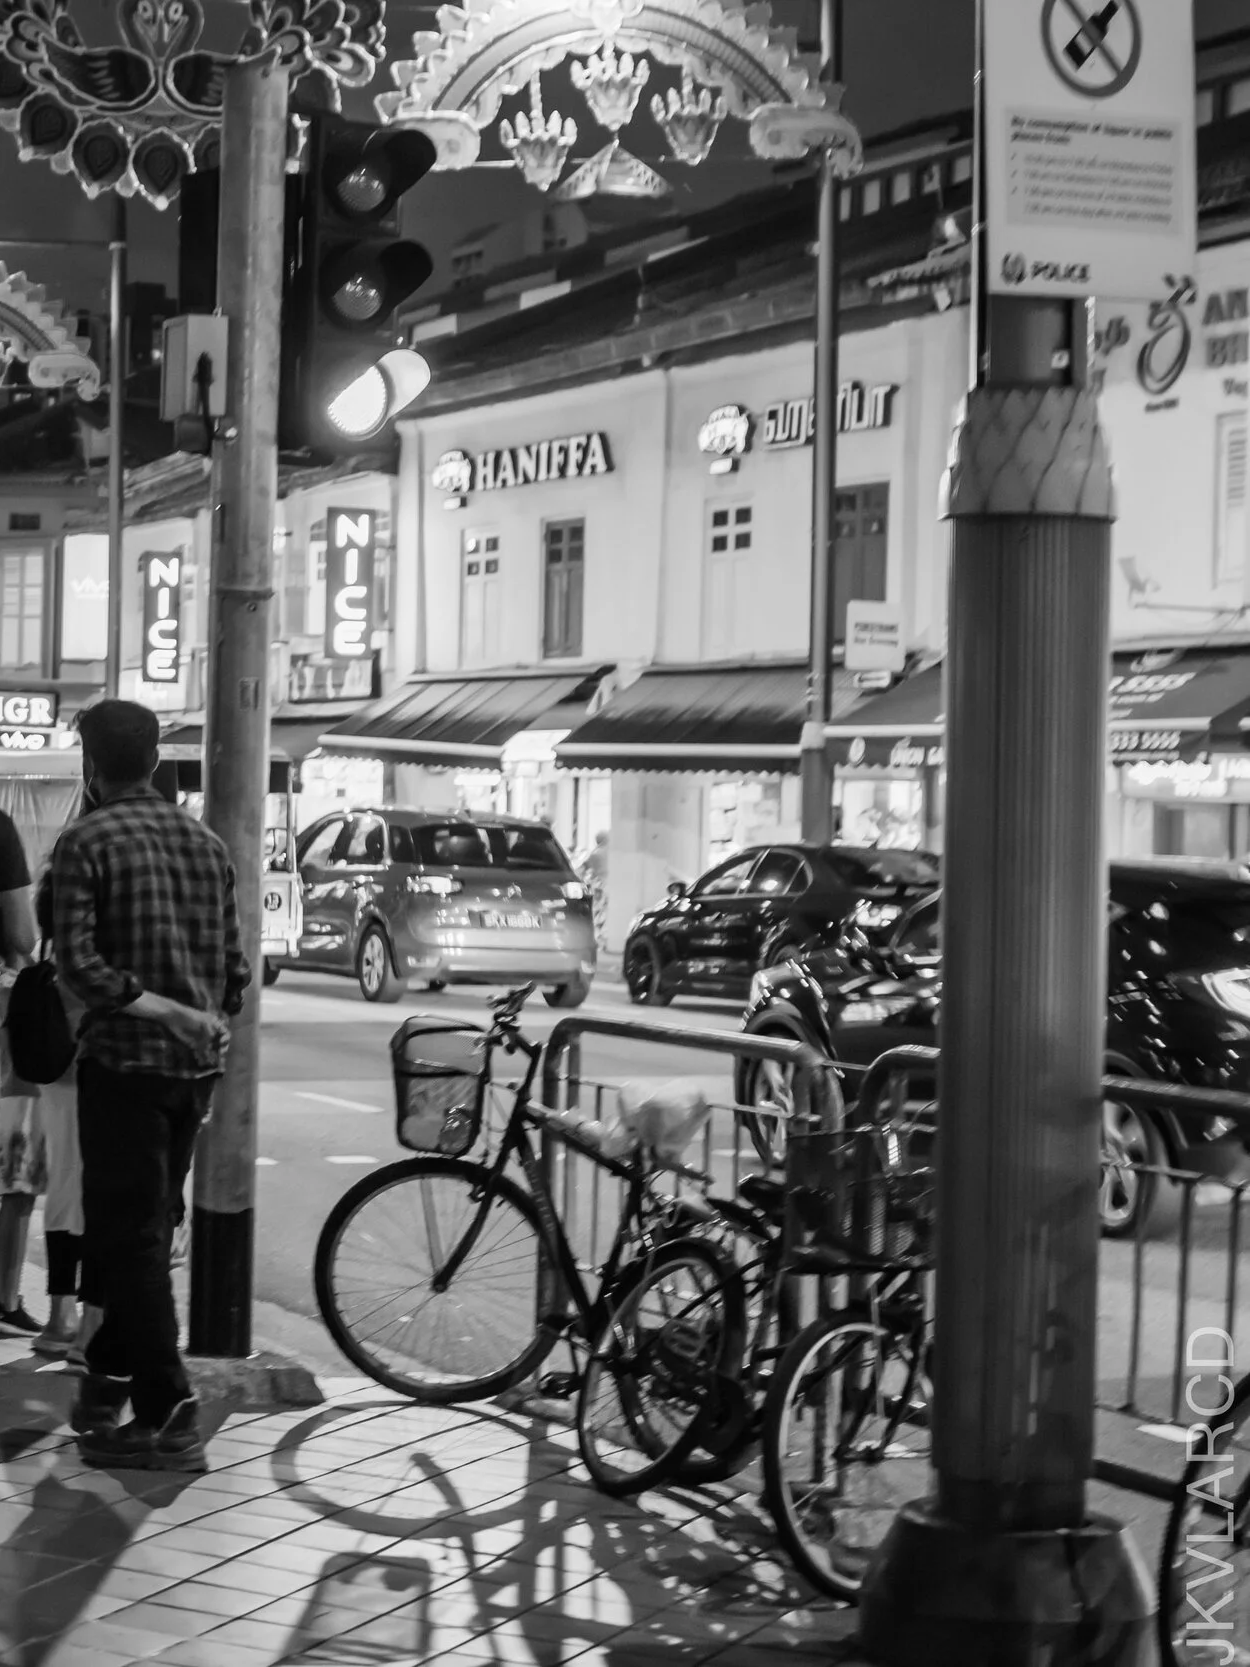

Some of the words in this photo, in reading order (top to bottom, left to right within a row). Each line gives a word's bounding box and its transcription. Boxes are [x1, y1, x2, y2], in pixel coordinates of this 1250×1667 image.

[475, 432, 608, 491] HANIFFA
[146, 557, 179, 680] NICE
[333, 513, 370, 656] NICE
